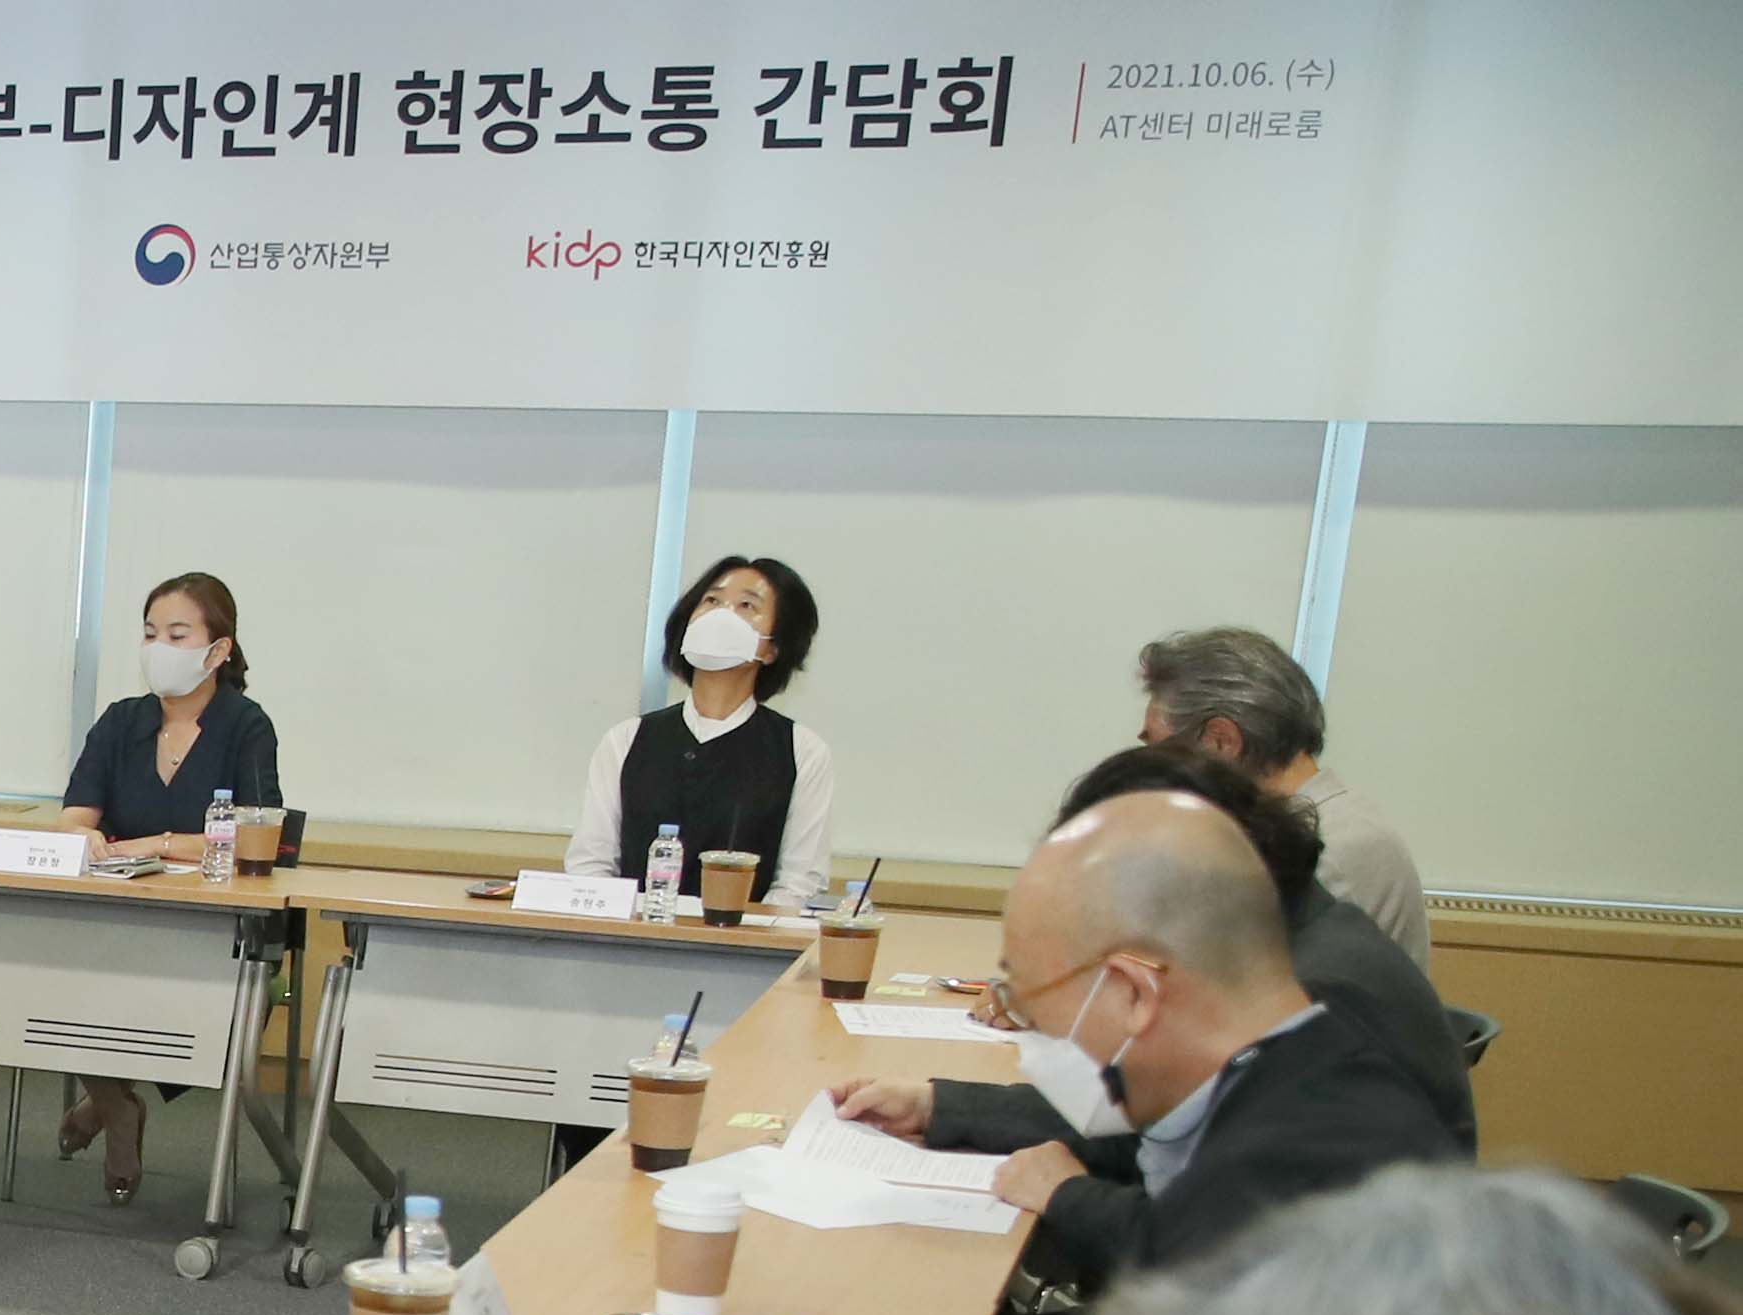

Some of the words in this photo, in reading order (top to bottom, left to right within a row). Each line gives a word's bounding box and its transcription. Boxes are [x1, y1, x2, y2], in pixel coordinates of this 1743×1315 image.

[1106, 62, 1274, 88] 2021.10.06.
[1285, 58, 1335, 91] (수)
[394, 64, 720, 155] 현장소통
[752, 55, 1015, 150] 간담회
[1099, 111, 1194, 140] AT센터
[1205, 109, 1323, 140] 미래로룸
[209, 241, 391, 271] 산업통상자원부
[526, 228, 621, 280] kidp
[633, 239, 830, 269] 한국디자인진흥원
